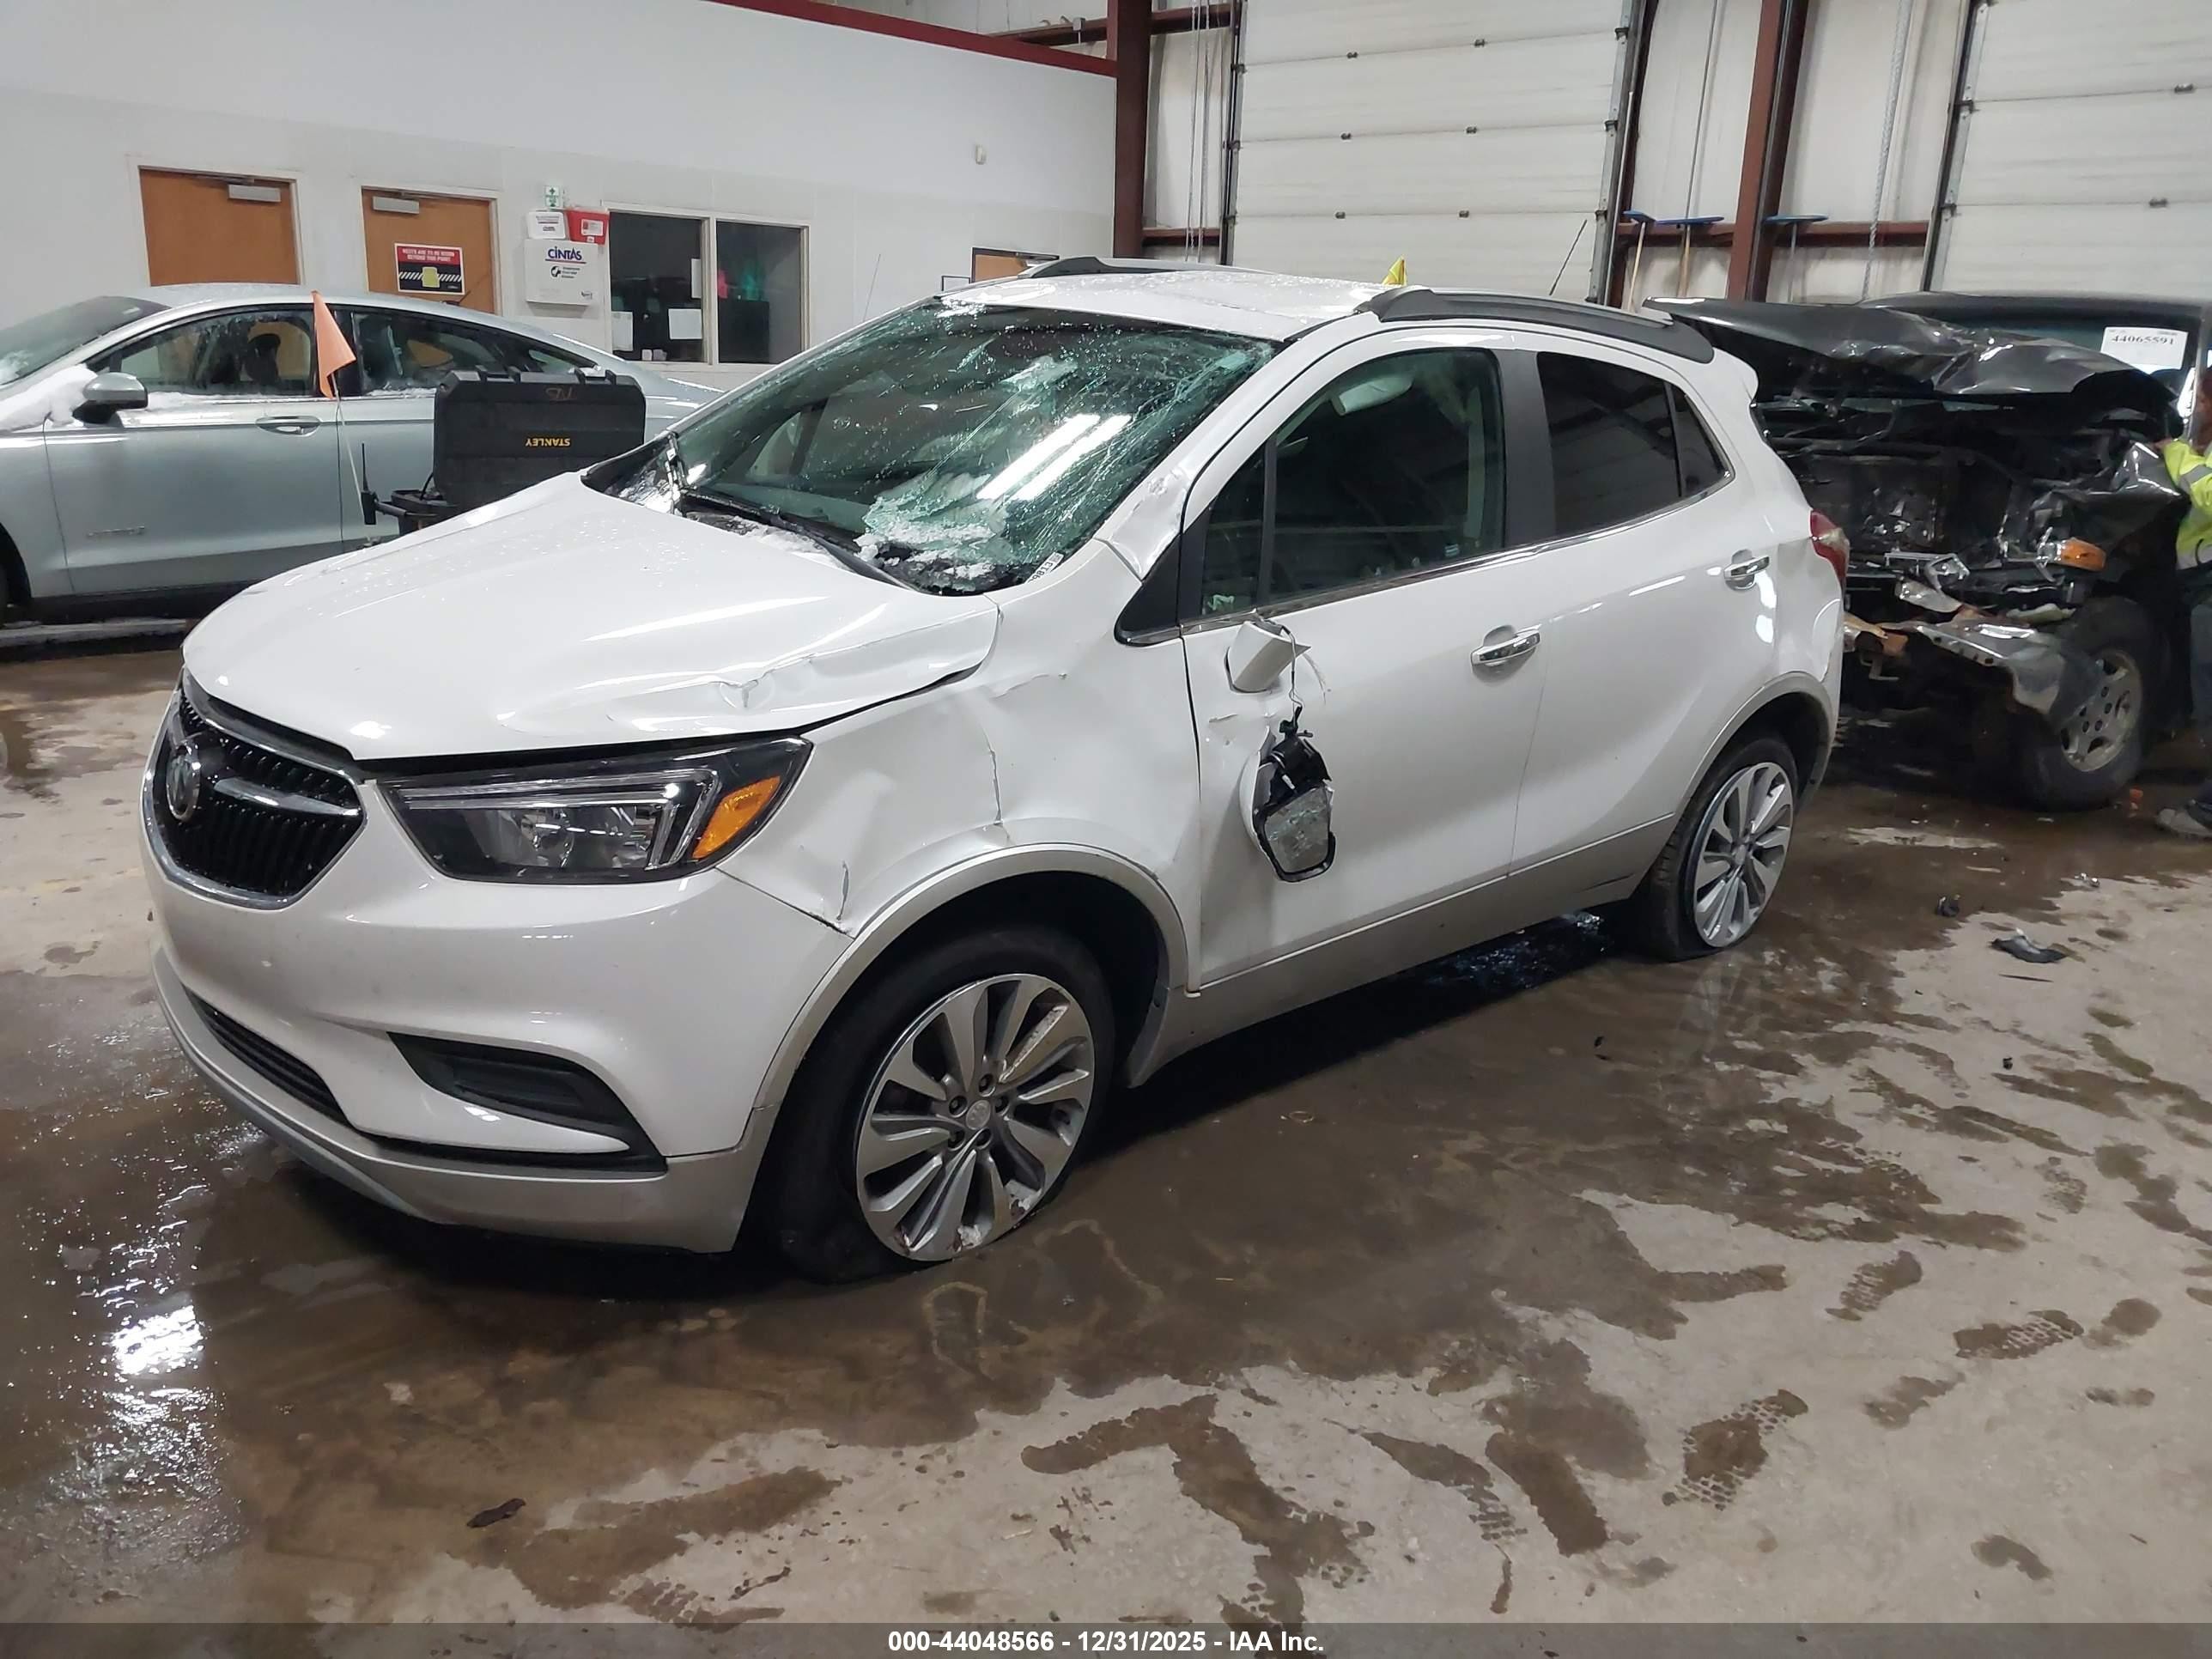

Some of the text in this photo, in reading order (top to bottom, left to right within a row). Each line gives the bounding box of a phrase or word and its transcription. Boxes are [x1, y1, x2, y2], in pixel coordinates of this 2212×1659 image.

[548, 246, 582, 260] CINTAS
[2112, 335, 2174, 344] 44065591
[525, 438, 571, 447] STANLEY
[1028, 562, 1054, 583] 9813
